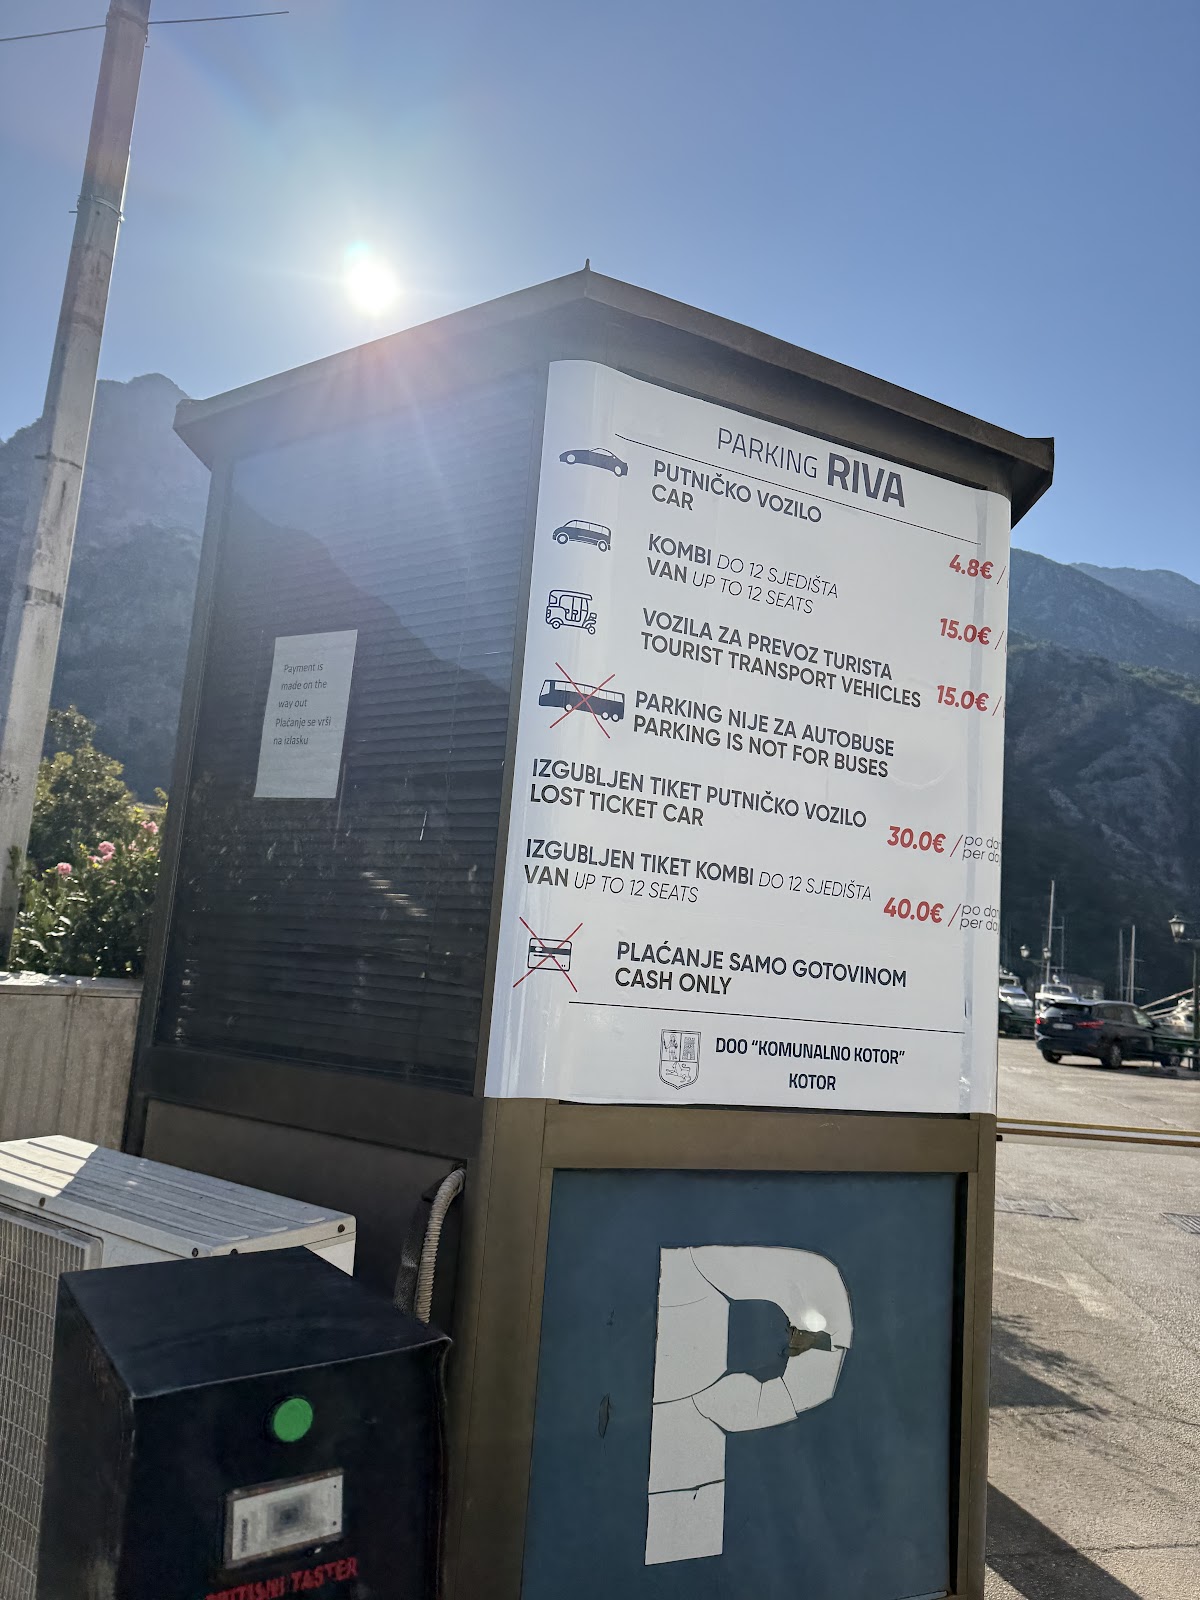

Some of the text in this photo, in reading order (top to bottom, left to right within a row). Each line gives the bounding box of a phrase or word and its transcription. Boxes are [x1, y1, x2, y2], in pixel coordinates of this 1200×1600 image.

[717, 427, 906, 508] PARKING RIVA
[651, 484, 694, 511] CAR
[653, 459, 822, 523] PUTNIČKO VOZILO
[648, 533, 839, 599] KOMBI DO 12 SJEDIŠTA
[949, 554, 994, 580] 4.8€
[646, 556, 814, 614] VAN UP TO 12 SEATS
[643, 607, 892, 681] VOZILA ZA PREVOZ TURISTA
[940, 617, 992, 645] 15.0€
[283, 662, 324, 675] Payment is
[640, 631, 921, 708] TOURIST TRANSPORT VEHICLES
[281, 679, 328, 691] made on the
[937, 684, 990, 712] 15.0€
[278, 698, 308, 709] way out
[307, 719, 316, 727] se
[318, 716, 332, 726] vrši
[635, 690, 895, 757] PARKING NIJE ZA AUTOBUSE
[273, 735, 308, 745] na izlasku
[633, 714, 889, 778] PARKING IS NOT FOR BUSES
[530, 783, 704, 827] LOST TICKET CAR
[532, 758, 867, 828] IZGUBLJEN TIKET PUTNIČKO VOZILO
[886, 825, 947, 854] 30.0€
[961, 848, 985, 861] per
[523, 864, 700, 903] VAN UP TO 12 SEATS
[526, 838, 872, 902] IZGUBLJEN TIKET KOMBI DO 12 SJEDIŠTA
[883, 896, 945, 924] 40.0€
[959, 917, 983, 931] per
[616, 940, 907, 988] PLAĆANJE SAMO GOTOVINOM
[615, 967, 733, 995] CASH ONLY
[715, 1037, 748, 1055] DOO
[789, 1073, 836, 1091] KOTOR
[645, 1245, 853, 1565] P
